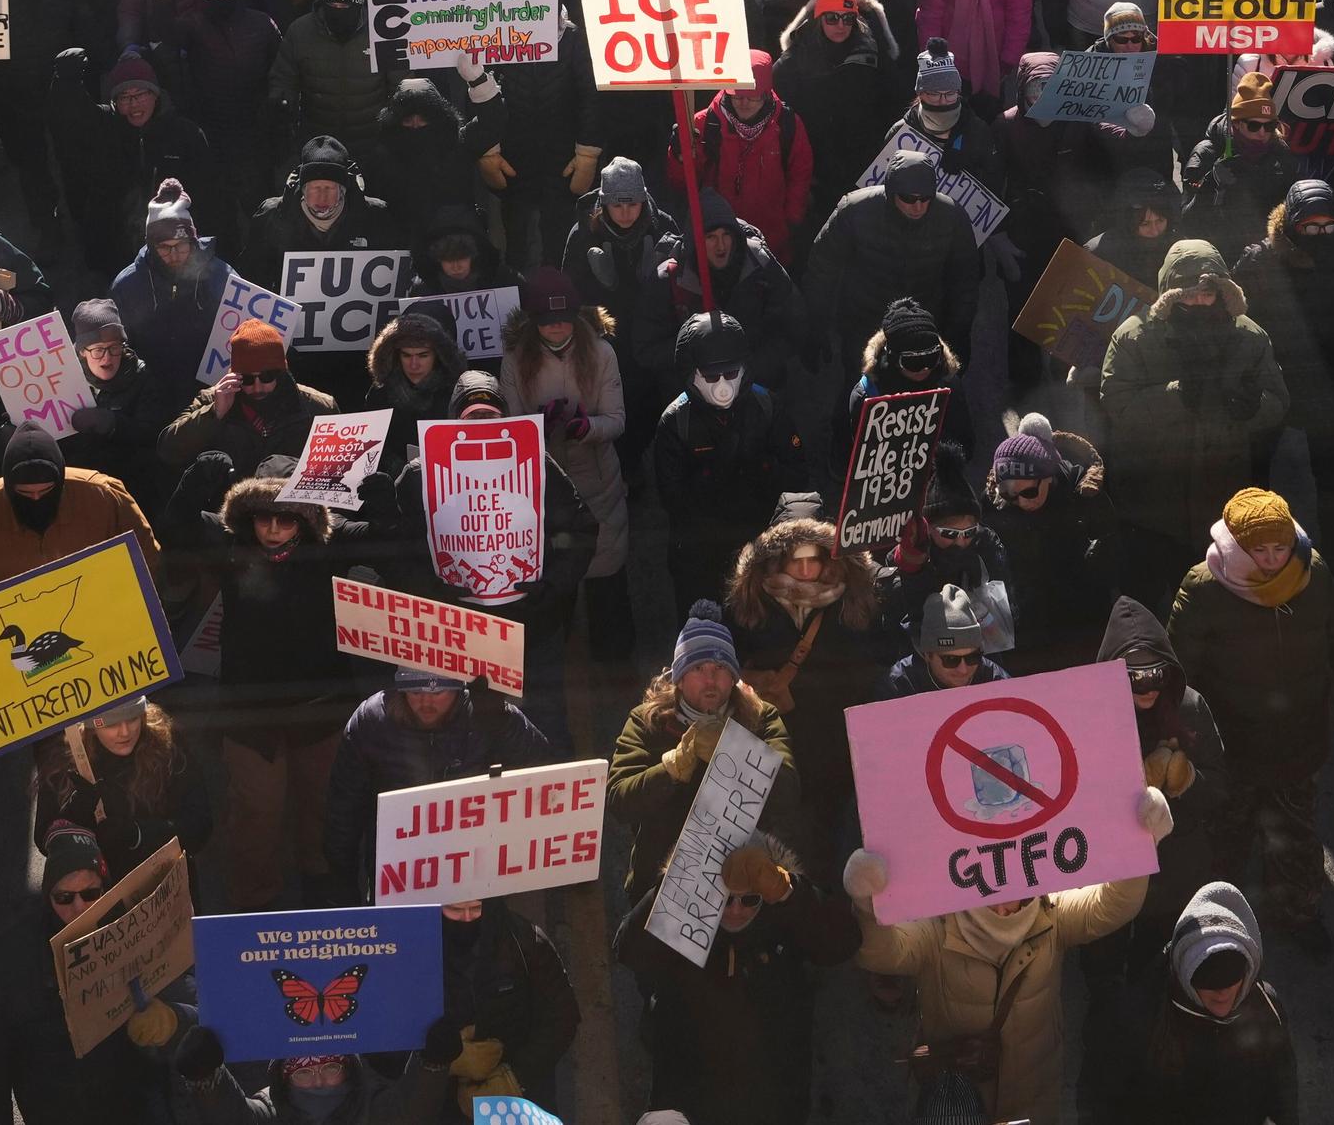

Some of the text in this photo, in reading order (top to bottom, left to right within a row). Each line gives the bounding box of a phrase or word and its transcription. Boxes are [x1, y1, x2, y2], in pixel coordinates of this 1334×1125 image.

[605, 30, 729, 75] OUT!
[1194, 25, 1280, 50] MSP
[864, 394, 939, 443] Resist
[900, 435, 930, 470] its
[468, 493, 505, 512] I.C.E.
[859, 469, 914, 509] 1938
[439, 530, 533, 552] MINNEAPOLIS
[460, 512, 513, 532] OUT OF
[336, 583, 516, 643] SUPPORT
[389, 616, 467, 649] OUR
[337, 625, 523, 691] NEIGHBORS
[13, 680, 94, 741] TREAD
[99, 666, 126, 699] ON
[126, 647, 165, 684] ME
[395, 777, 596, 841] JUSTICE
[379, 828, 598, 896] NOT LIES
[947, 826, 1089, 898] GTFO
[240, 939, 398, 963] our neighbors
[257, 924, 378, 944] We protect
